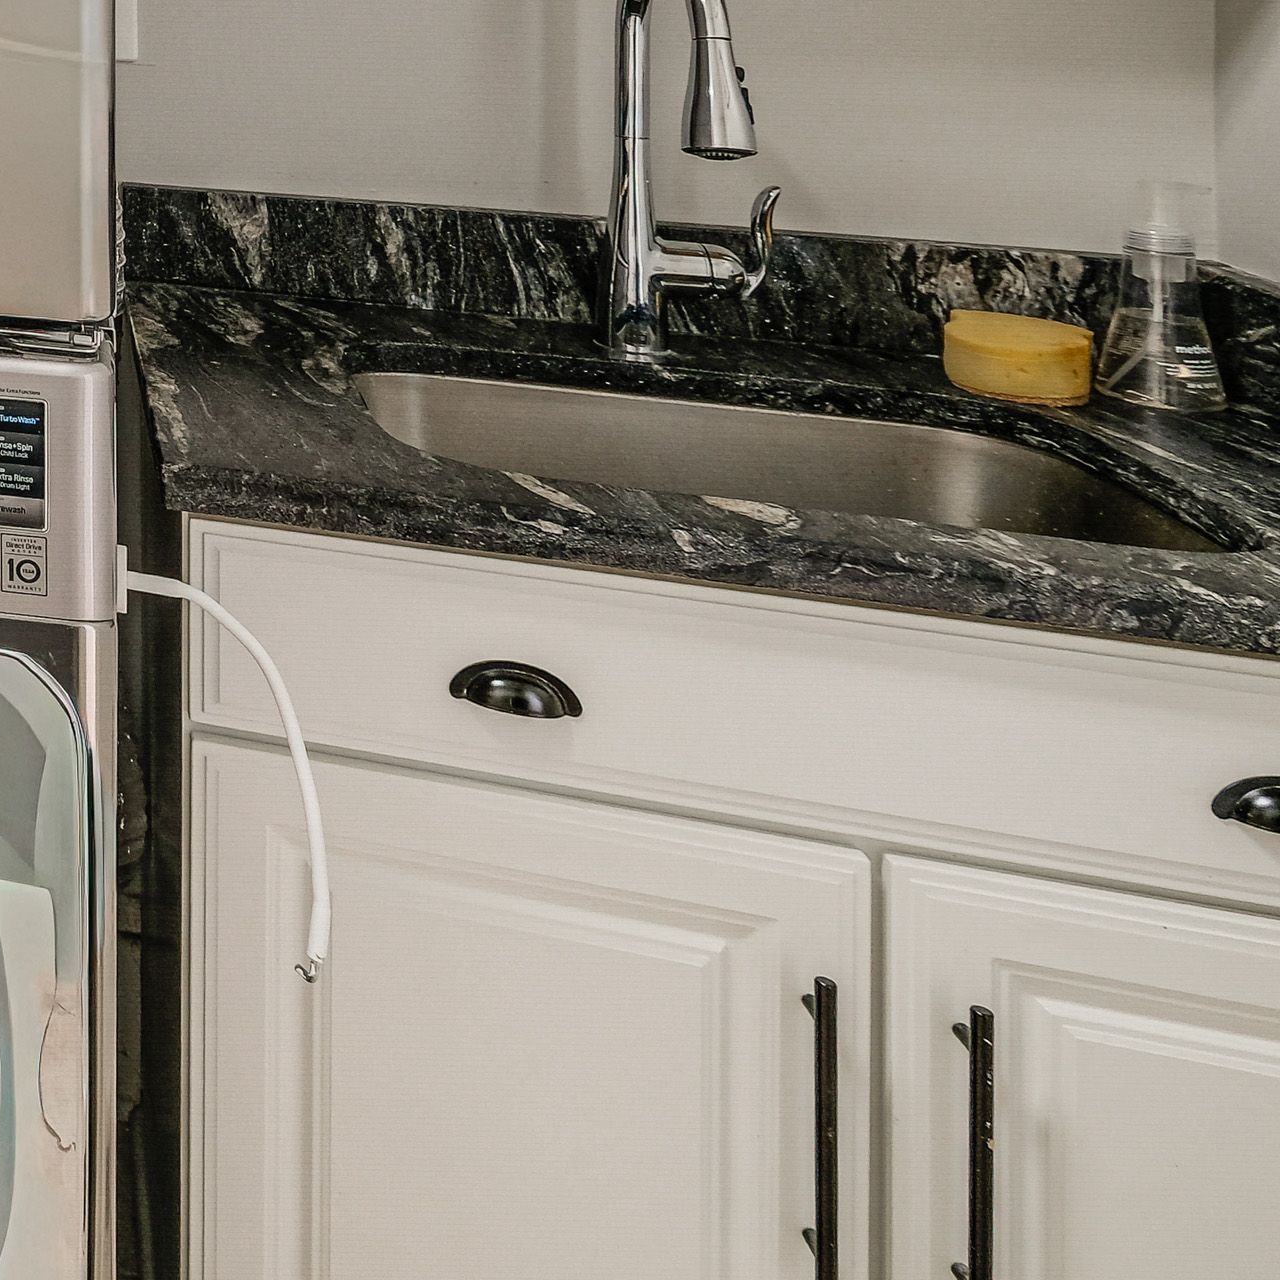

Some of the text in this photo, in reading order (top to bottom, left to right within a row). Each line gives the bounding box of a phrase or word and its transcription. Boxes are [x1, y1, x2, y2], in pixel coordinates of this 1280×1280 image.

[14, 451, 29, 459] Lock
[13, 474, 33, 483] Rinse
[15, 482, 30, 491] Light
[5, 541, 42, 551] Direct Drive
[7, 558, 41, 584] 10
